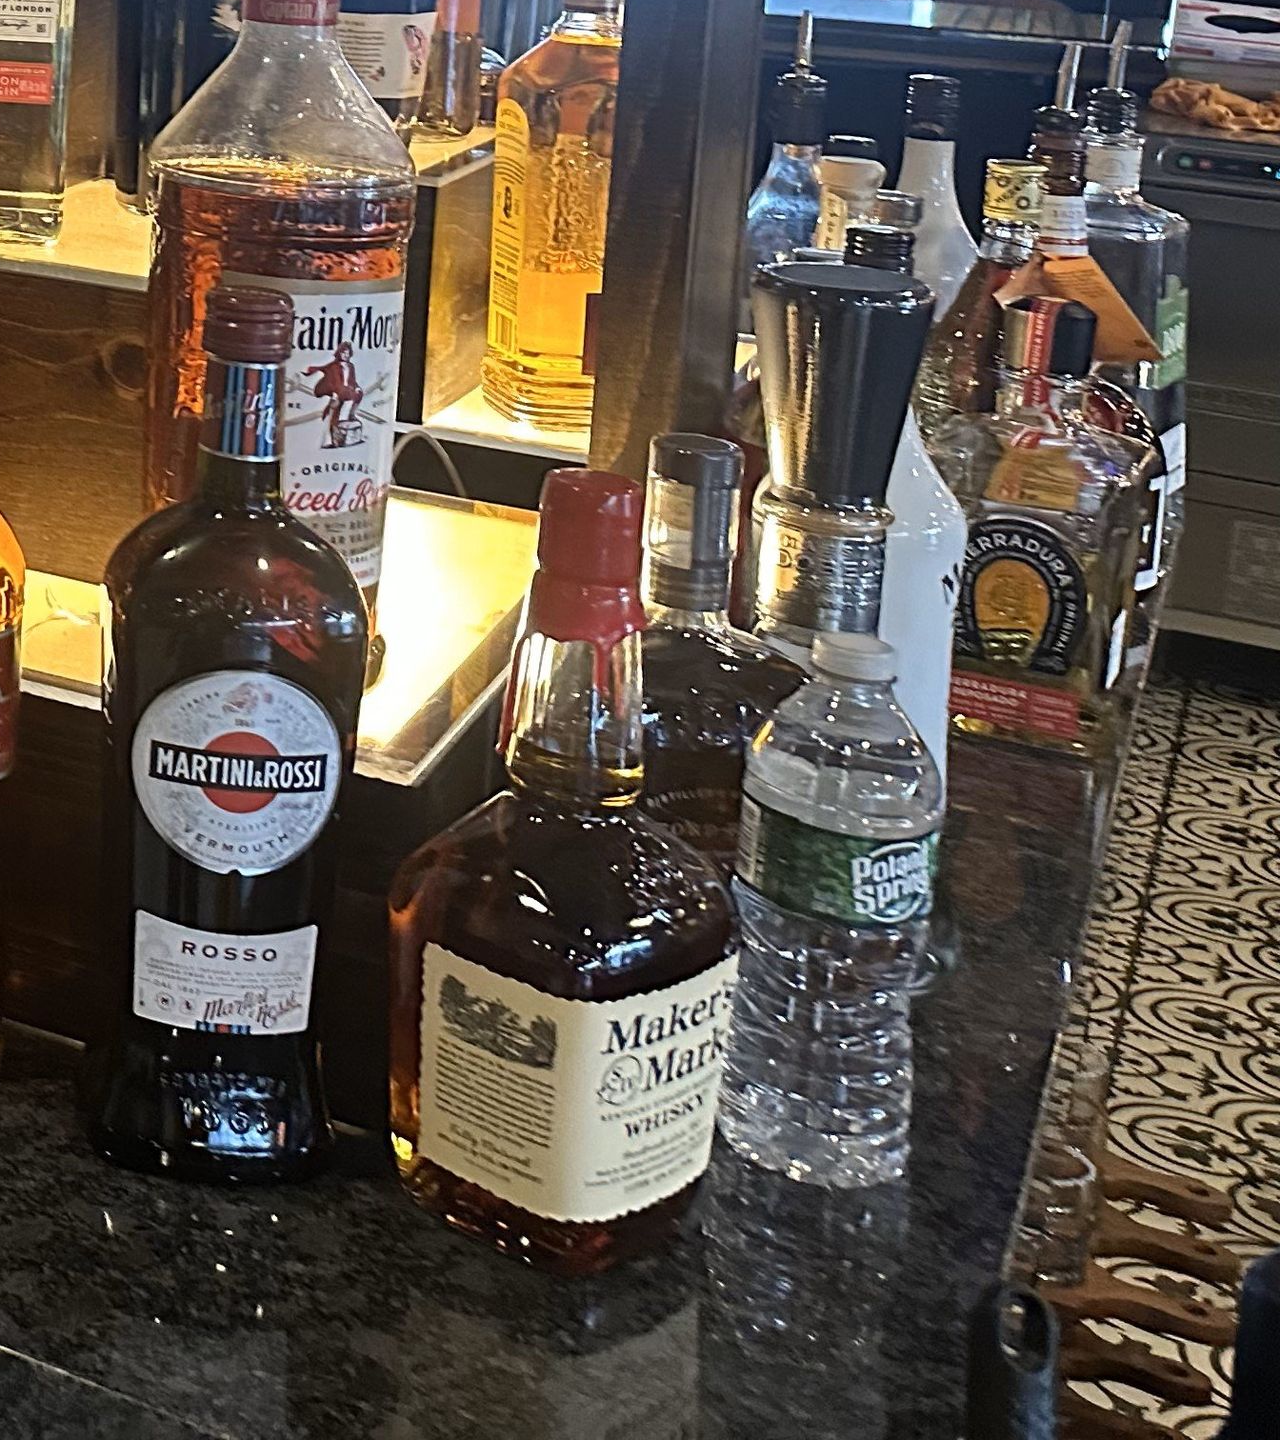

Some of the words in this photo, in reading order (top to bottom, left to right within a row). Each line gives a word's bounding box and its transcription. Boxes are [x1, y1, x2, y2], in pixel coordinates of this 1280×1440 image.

[10, 4, 52, 13] LONDON
[301, 462, 370, 476] ORIGINAL
[286, 482, 348, 512] iced
[156, 747, 322, 790] MARTINI&ROSSI
[184, 825, 289, 854] VERMOUTH
[182, 941, 278, 962] ROSSO
[641, 1027, 728, 1093] Mark
[624, 1093, 704, 1139] WHISKY
